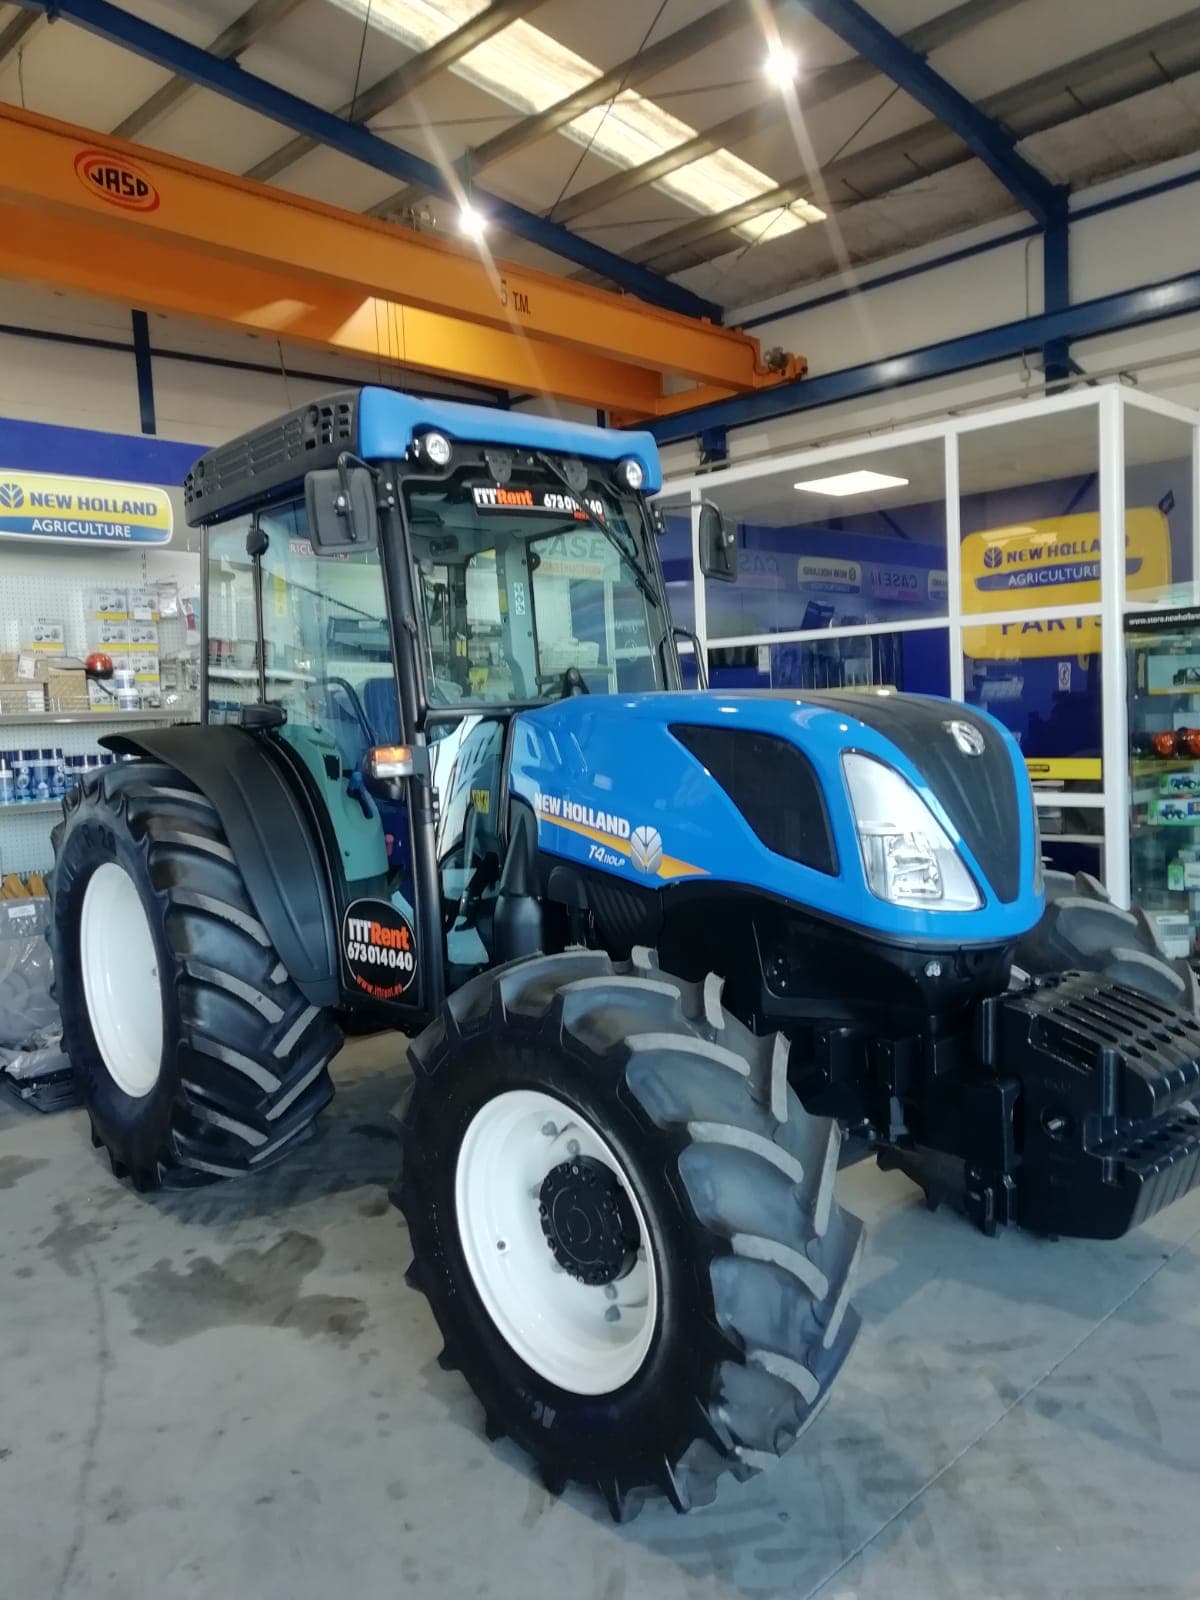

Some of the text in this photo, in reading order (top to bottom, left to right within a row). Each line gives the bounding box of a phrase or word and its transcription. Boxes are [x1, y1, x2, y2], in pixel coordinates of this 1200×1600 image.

[30, 491, 158, 516] NEW HOLLAND
[32, 518, 132, 538] AGRICULTURE
[1007, 546, 1043, 564] NEW
[1008, 565, 1100, 586] AGRICULTURE
[534, 791, 631, 839] NEW HOLLAND
[347, 941, 414, 972] 673014040
